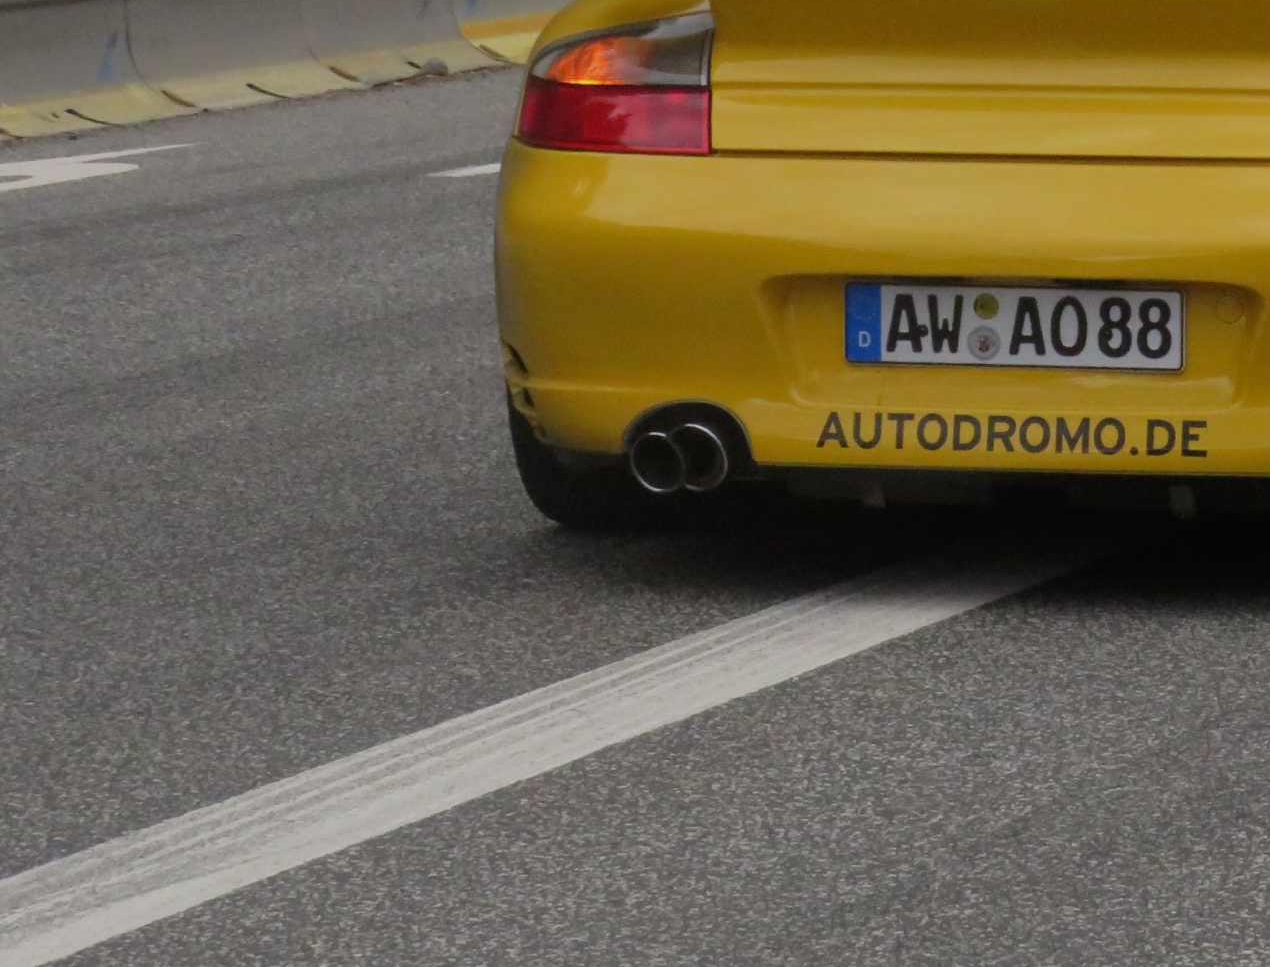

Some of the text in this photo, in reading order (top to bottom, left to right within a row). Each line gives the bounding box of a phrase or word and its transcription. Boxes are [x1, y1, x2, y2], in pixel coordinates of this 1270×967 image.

[857, 331, 871, 348] D
[885, 293, 964, 354] AW
[815, 411, 1209, 458] AUTODROMO.DE
